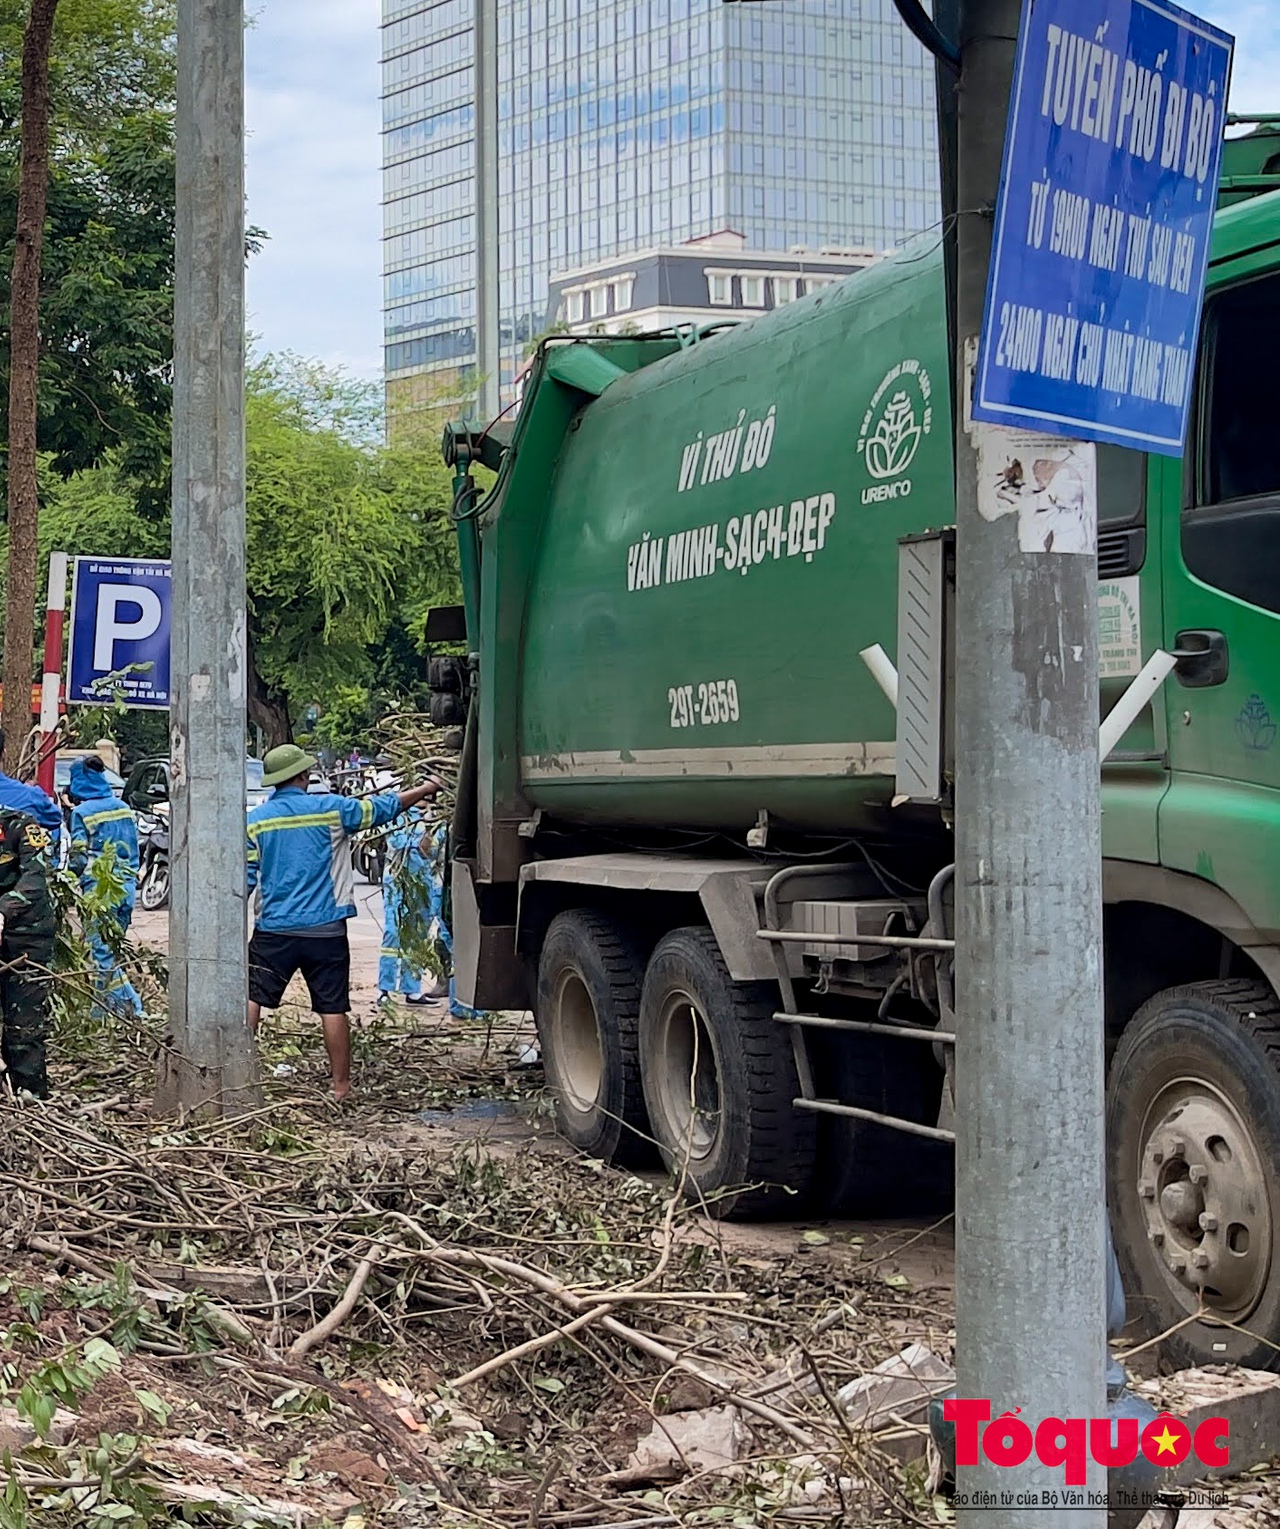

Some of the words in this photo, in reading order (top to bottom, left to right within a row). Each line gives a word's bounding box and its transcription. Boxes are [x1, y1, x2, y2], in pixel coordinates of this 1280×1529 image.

[1041, 20, 1119, 143] TUYẾN
[1115, 49, 1169, 162] PHỐ
[1160, 80, 1187, 172] ĐI
[1183, 79, 1216, 202] BỘ
[1026, 167, 1051, 249] TỪ
[1049, 188, 1090, 260] 19H00
[1088, 194, 1124, 272] NGÀY
[1124, 202, 1152, 280] THỨ
[995, 301, 1042, 373] 24H00
[1041, 302, 1079, 381] NGÀY
[1076, 302, 1104, 388] CHỦ
[1101, 319, 1134, 407] NHẬT
[1131, 326, 1162, 400] HÀNG
[677, 431, 703, 492] VÌ
[700, 408, 747, 485] THỦ
[740, 404, 777, 473] ĐÔ
[861, 479, 912, 504] URENCO
[627, 531, 663, 591] VĂN
[93, 583, 162, 671] P
[668, 679, 739, 727] 29T-2659
